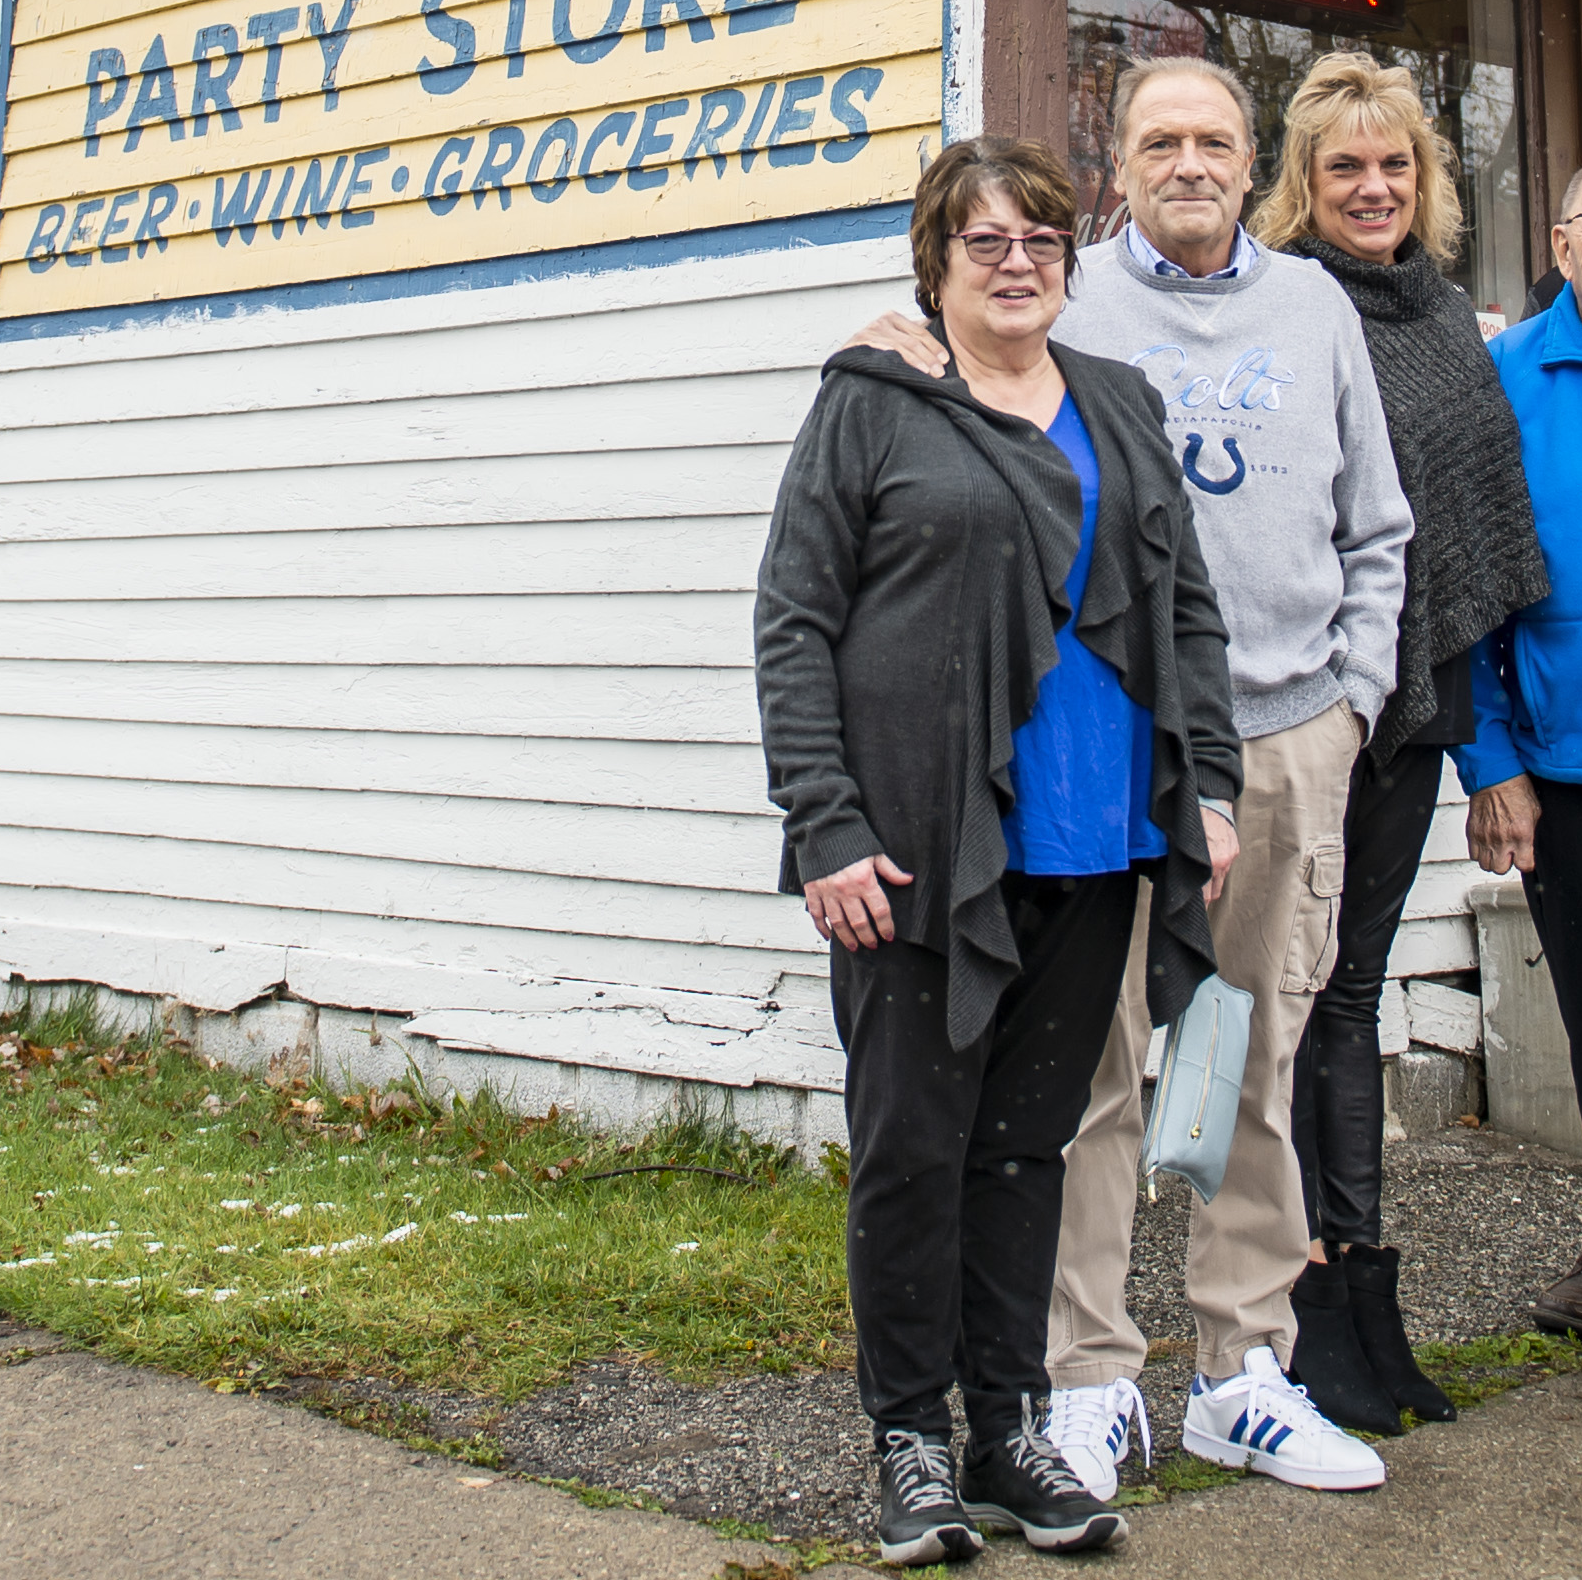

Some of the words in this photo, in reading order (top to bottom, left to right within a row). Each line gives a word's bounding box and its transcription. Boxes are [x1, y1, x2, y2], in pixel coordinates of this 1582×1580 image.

[421, 66, 885, 217] GROCERIES
[1128, 343, 1297, 411] Colts
[1250, 464, 1288, 475] 1953
